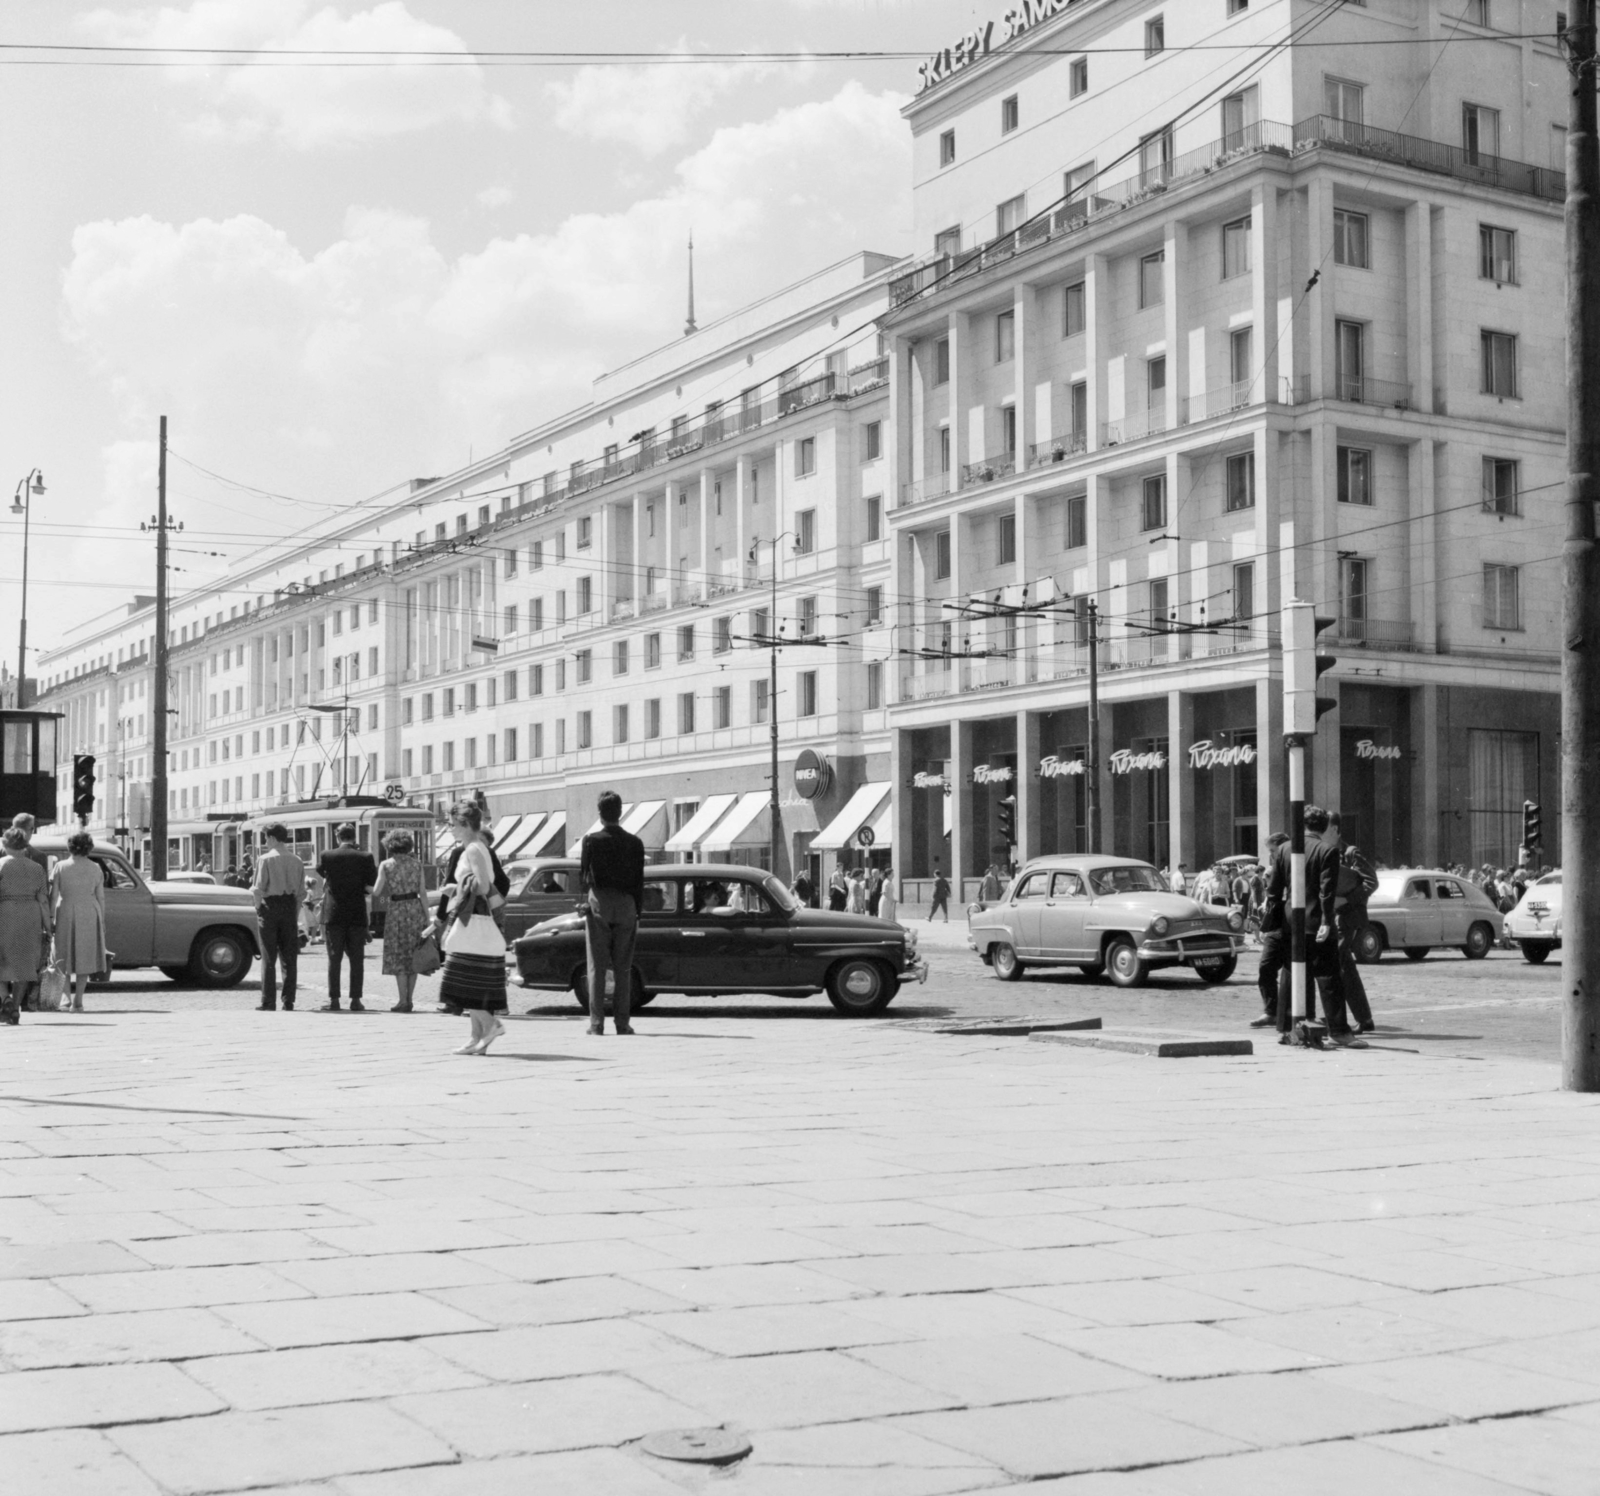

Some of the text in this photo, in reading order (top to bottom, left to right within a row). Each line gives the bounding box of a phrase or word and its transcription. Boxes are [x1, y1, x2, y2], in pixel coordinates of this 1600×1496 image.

[914, 21, 994, 93] SKLEPY
[1188, 740, 1258, 770] Roxana
[1356, 740, 1402, 760] Roxana
[1110, 749, 1166, 774] Roxana
[795, 768, 817, 780] NIVEA
[386, 785, 404, 800] 25
